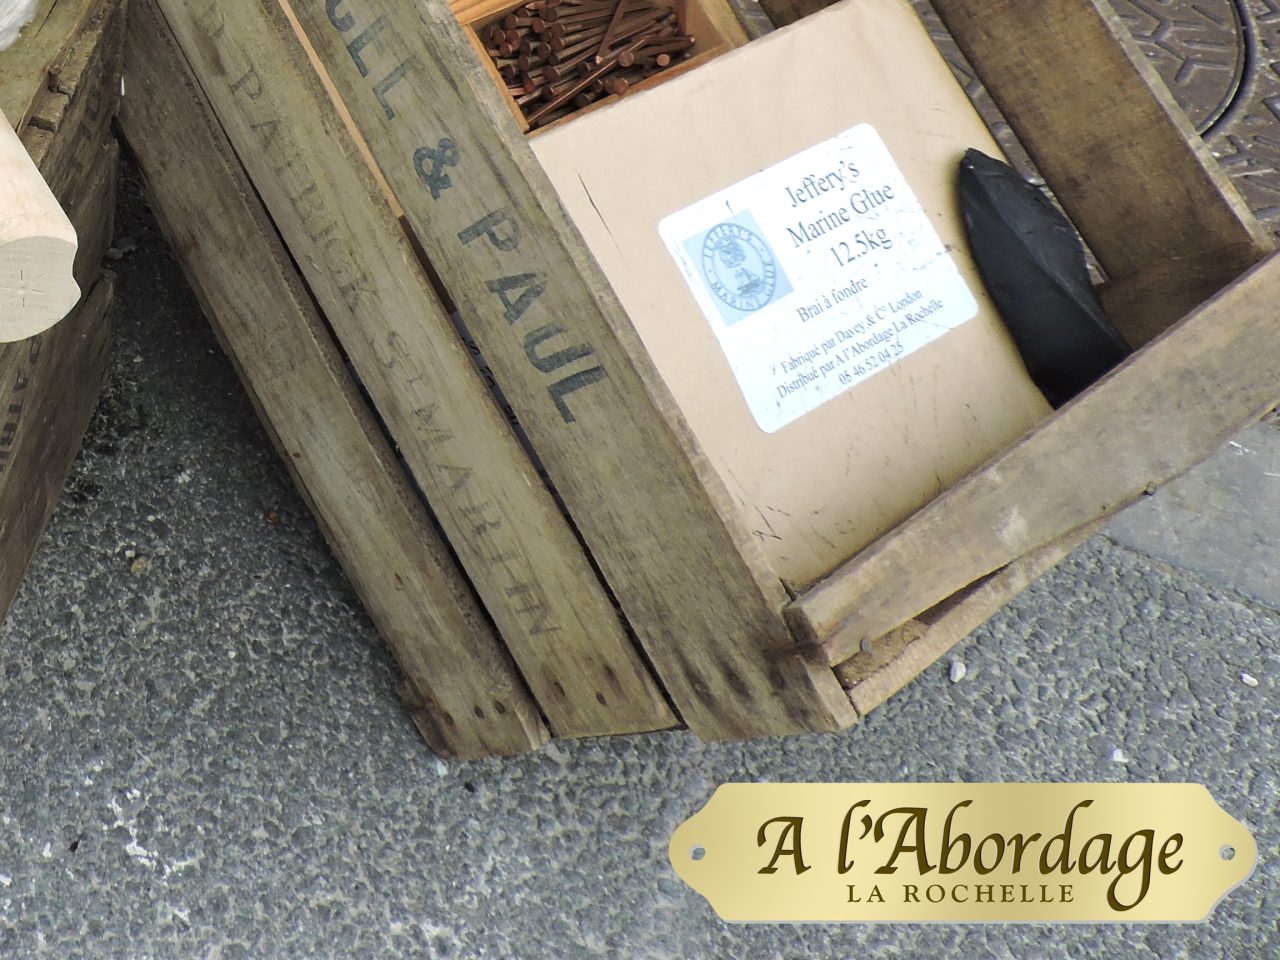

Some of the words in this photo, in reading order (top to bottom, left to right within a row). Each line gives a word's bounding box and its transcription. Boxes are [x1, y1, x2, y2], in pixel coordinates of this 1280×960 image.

[784, 160, 861, 208] Jeffery's
[786, 207, 851, 248] Marine
[850, 185, 895, 215] Glue
[830, 228, 894, 267] 12.5kg
[412, 136, 461, 200] &
[458, 206, 609, 425] PAUL
[796, 299, 824, 323] Brai
[822, 294, 833, 309] à
[830, 275, 869, 305] fondre
[776, 368, 819, 399] Distribué
[819, 362, 836, 378] par
[834, 354, 846, 366] A
[842, 327, 894, 361] l'Abordage
[892, 319, 909, 333] La
[905, 298, 944, 325] Rochelle
[780, 344, 821, 374] Fabriqué
[821, 337, 836, 355] par
[835, 321, 866, 344] Davey
[865, 314, 877, 328] &
[888, 289, 924, 314] London
[853, 364, 866, 378] 46
[865, 356, 879, 371] 52
[878, 348, 892, 364] 04
